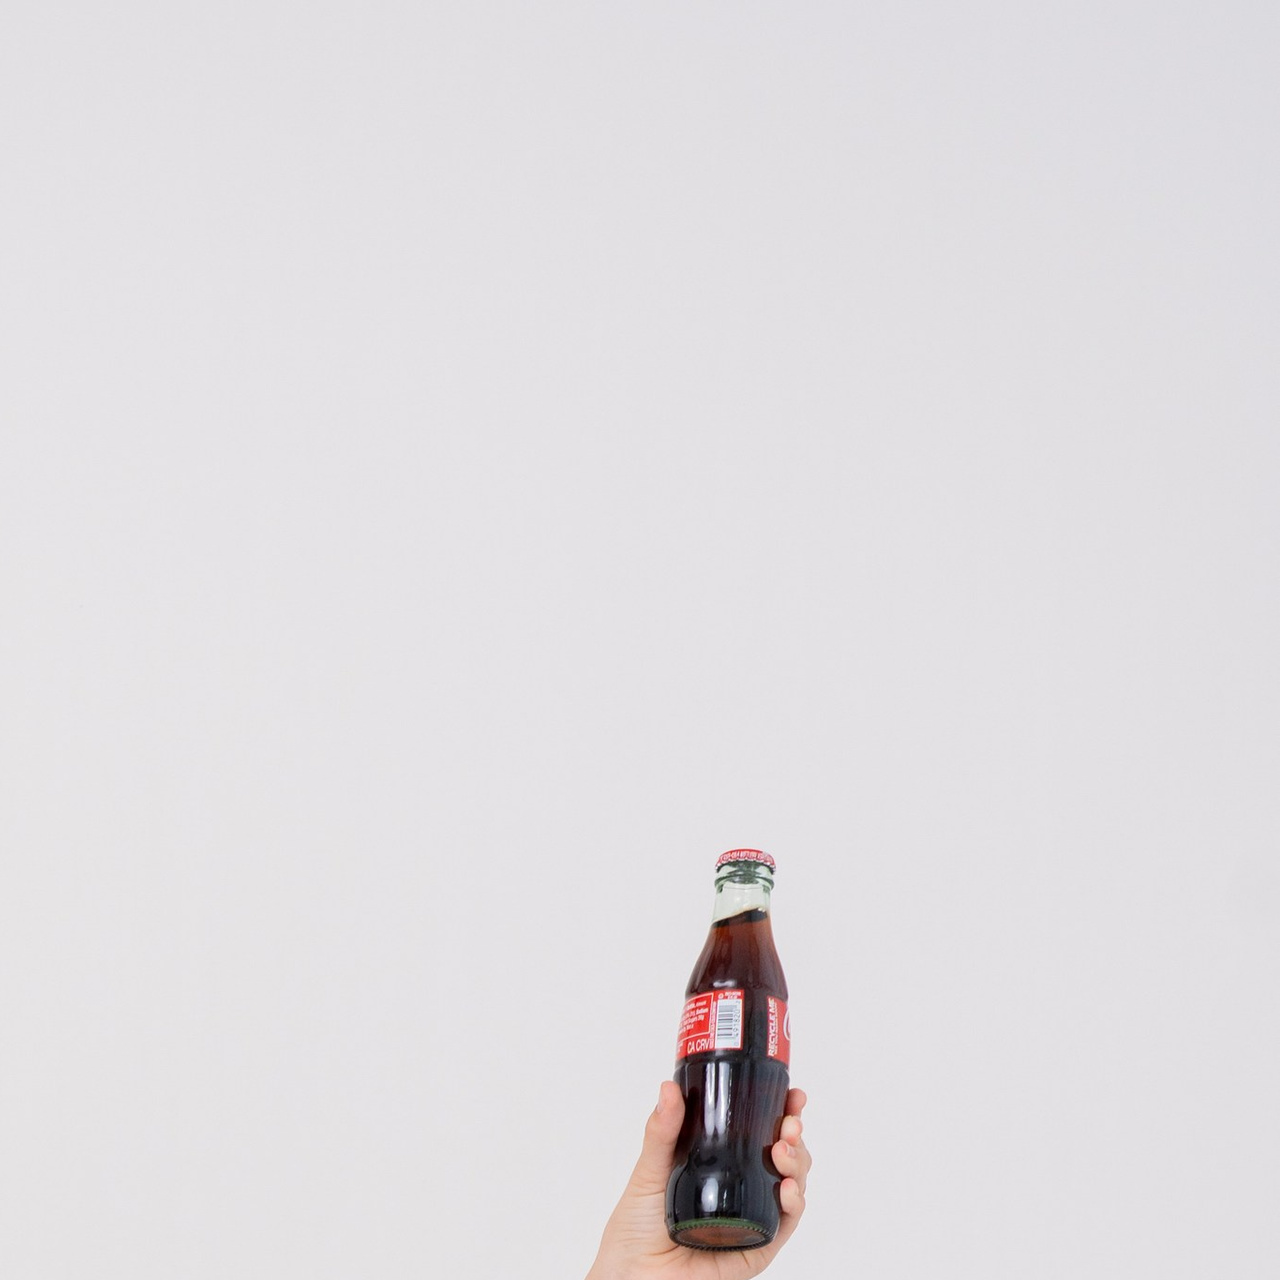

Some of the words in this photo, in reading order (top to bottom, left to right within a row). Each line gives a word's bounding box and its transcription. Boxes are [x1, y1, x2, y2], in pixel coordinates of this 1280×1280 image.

[768, 997, 776, 1013] ME
[768, 1014, 776, 1057] RECYCLE
[687, 1041, 696, 1054] CA
